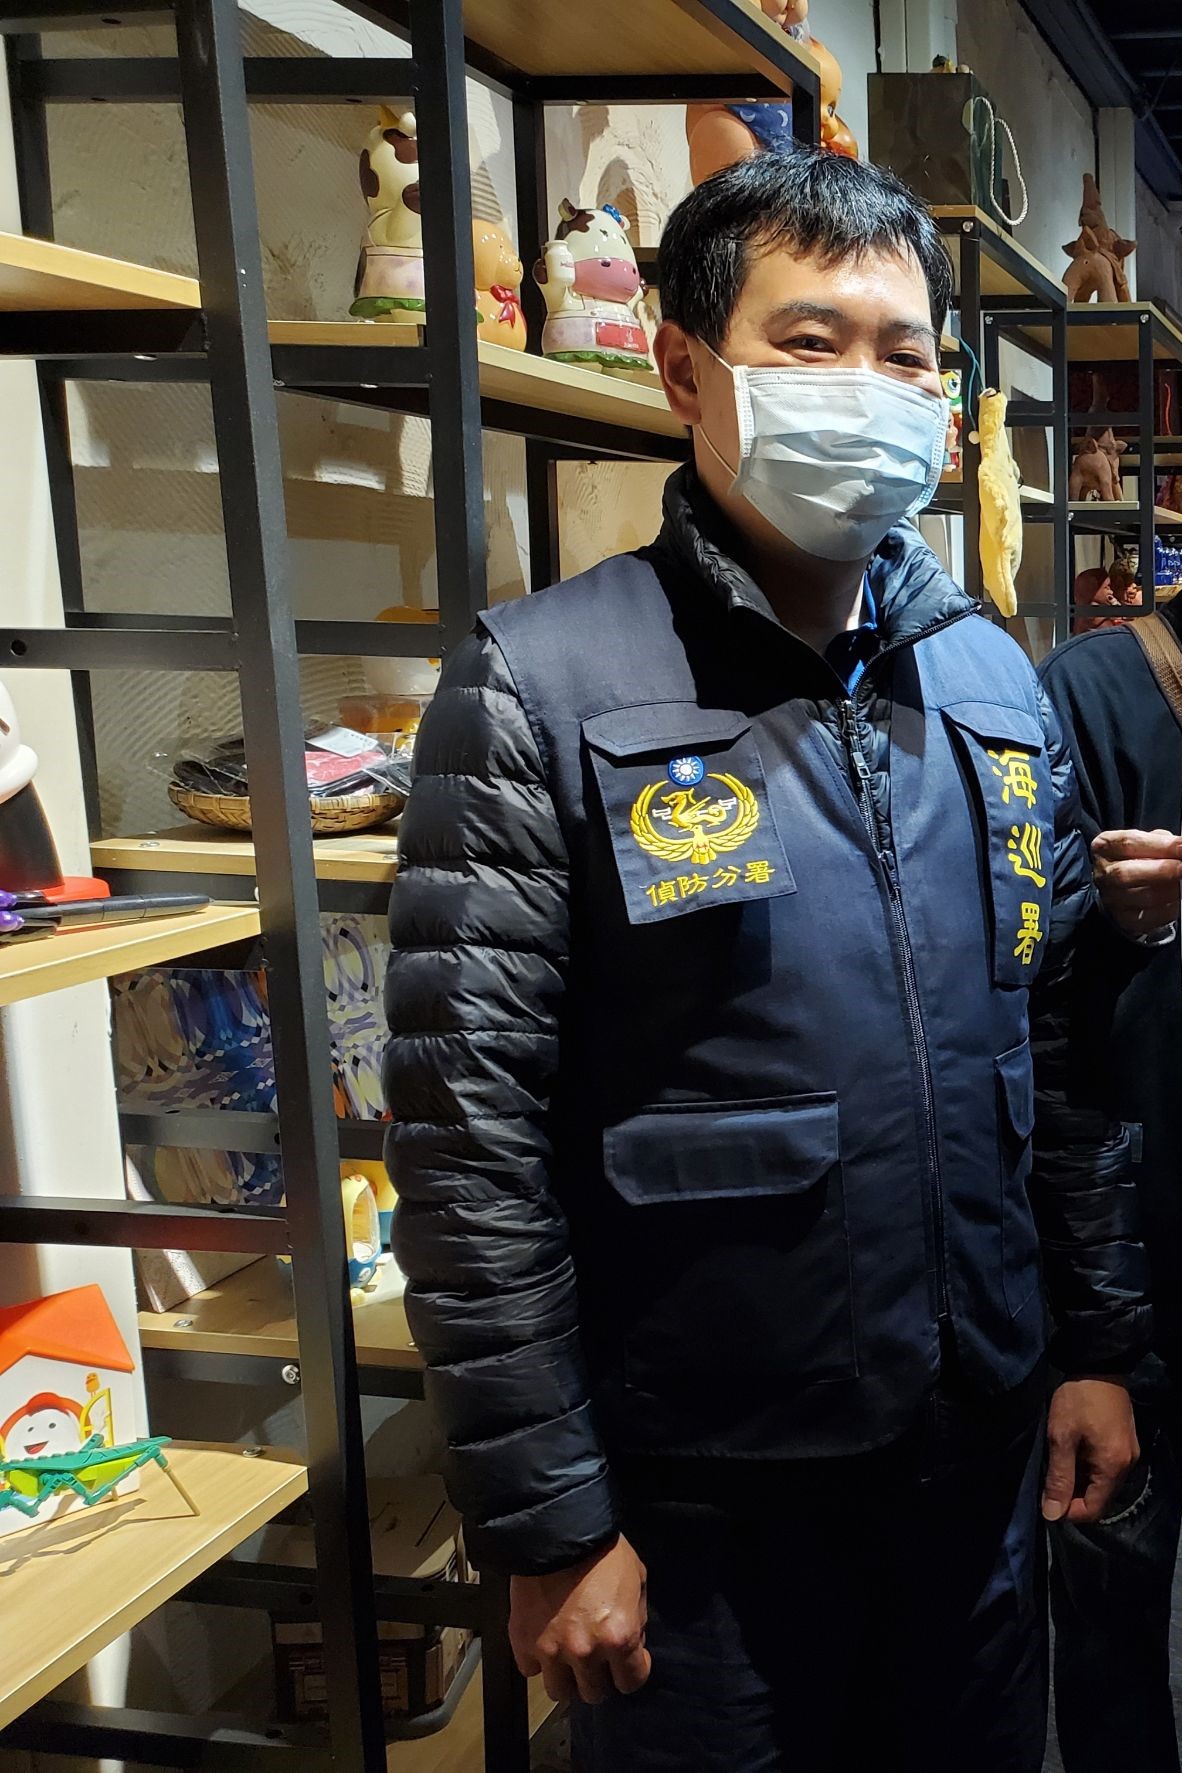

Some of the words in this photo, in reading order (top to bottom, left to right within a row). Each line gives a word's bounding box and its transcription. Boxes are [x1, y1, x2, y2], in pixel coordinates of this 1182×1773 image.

[646, 860, 776, 907] 偵防分署
[987, 749, 1046, 964] 海巡署
